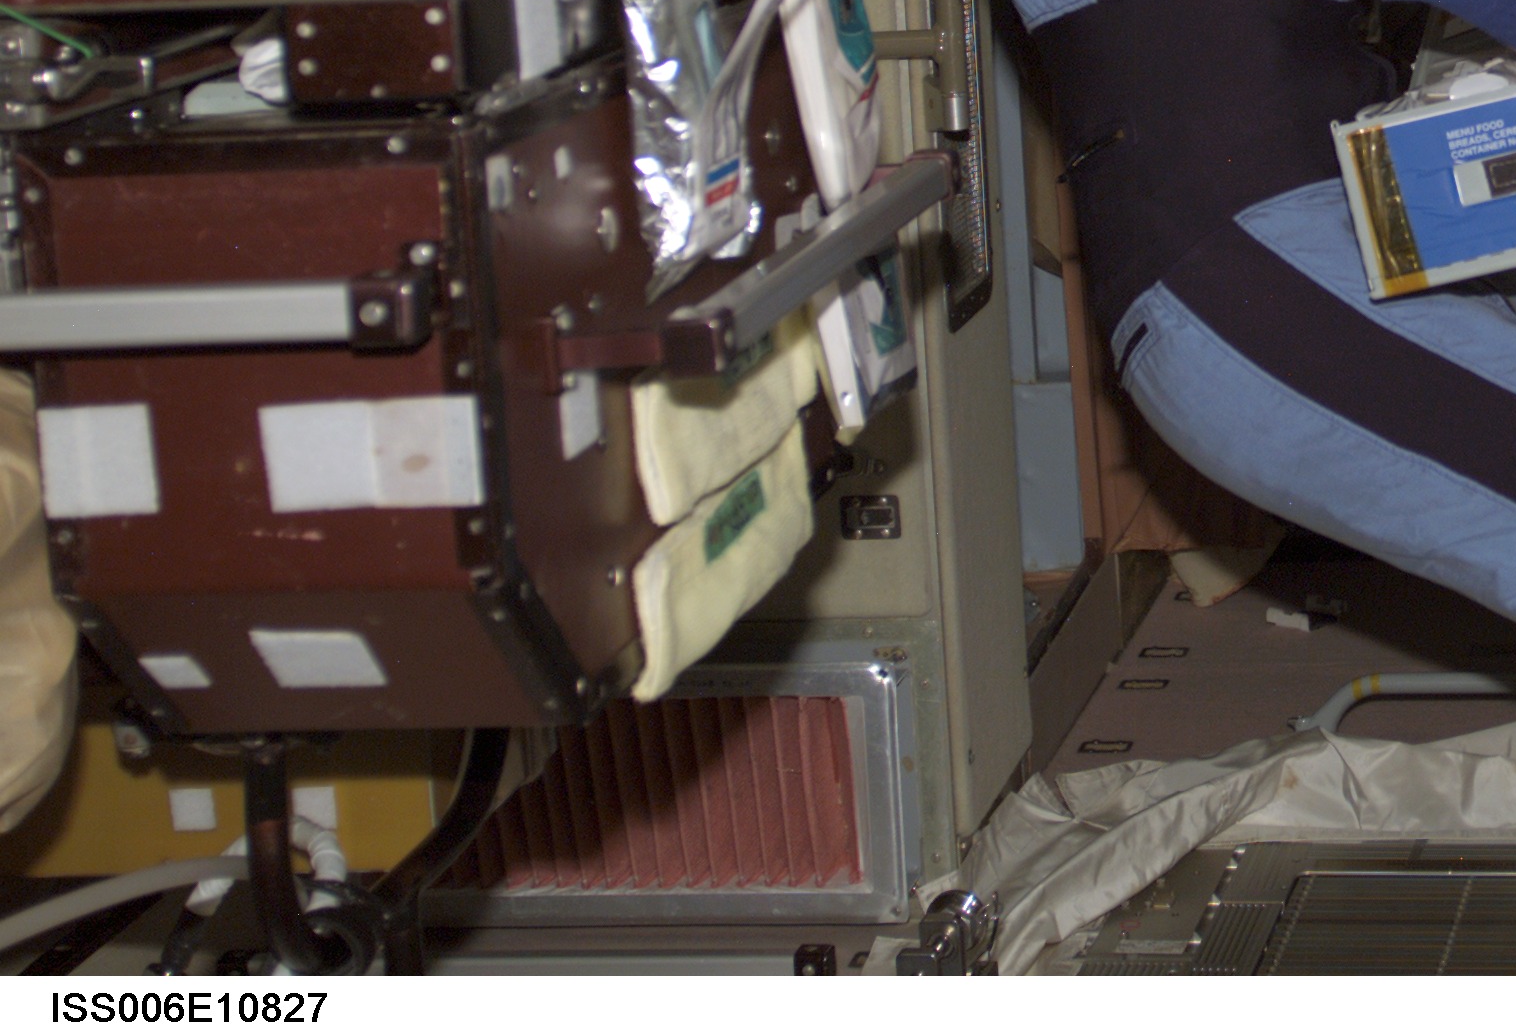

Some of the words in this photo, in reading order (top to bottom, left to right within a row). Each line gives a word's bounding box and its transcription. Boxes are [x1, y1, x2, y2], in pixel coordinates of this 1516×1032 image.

[1446, 127, 1475, 139] MENU
[1476, 119, 1504, 132] FOOD
[1449, 135, 1490, 149] BREADS,
[1451, 139, 1507, 160] CONTAINER
